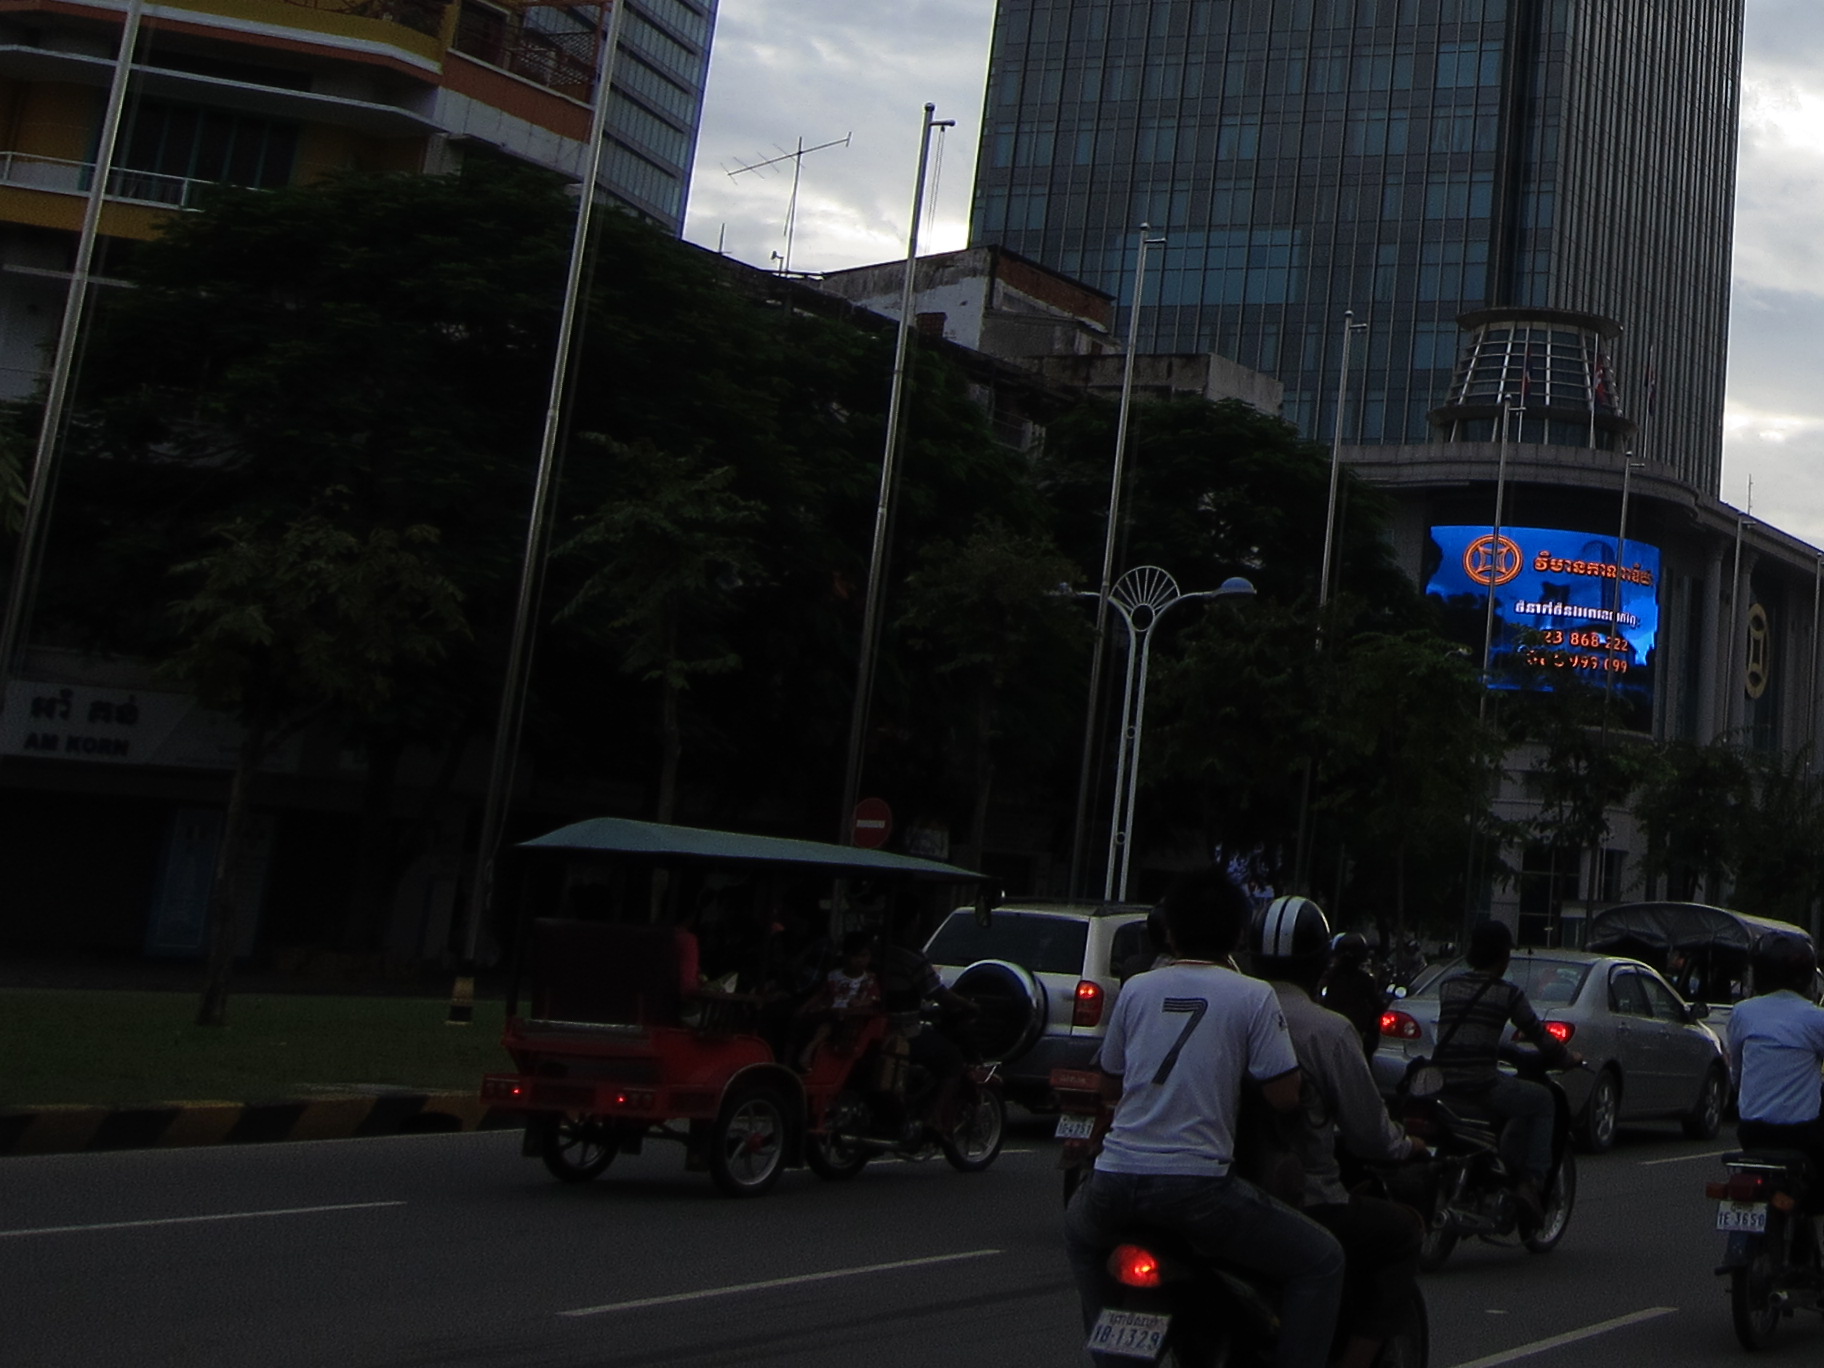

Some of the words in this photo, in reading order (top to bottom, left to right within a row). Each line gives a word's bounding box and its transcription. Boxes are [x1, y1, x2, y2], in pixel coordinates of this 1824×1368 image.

[1570, 632, 1599, 648] 868
[24, 732, 59, 751] AM
[65, 735, 130, 757] KORN
[1152, 996, 1209, 1086] 7
